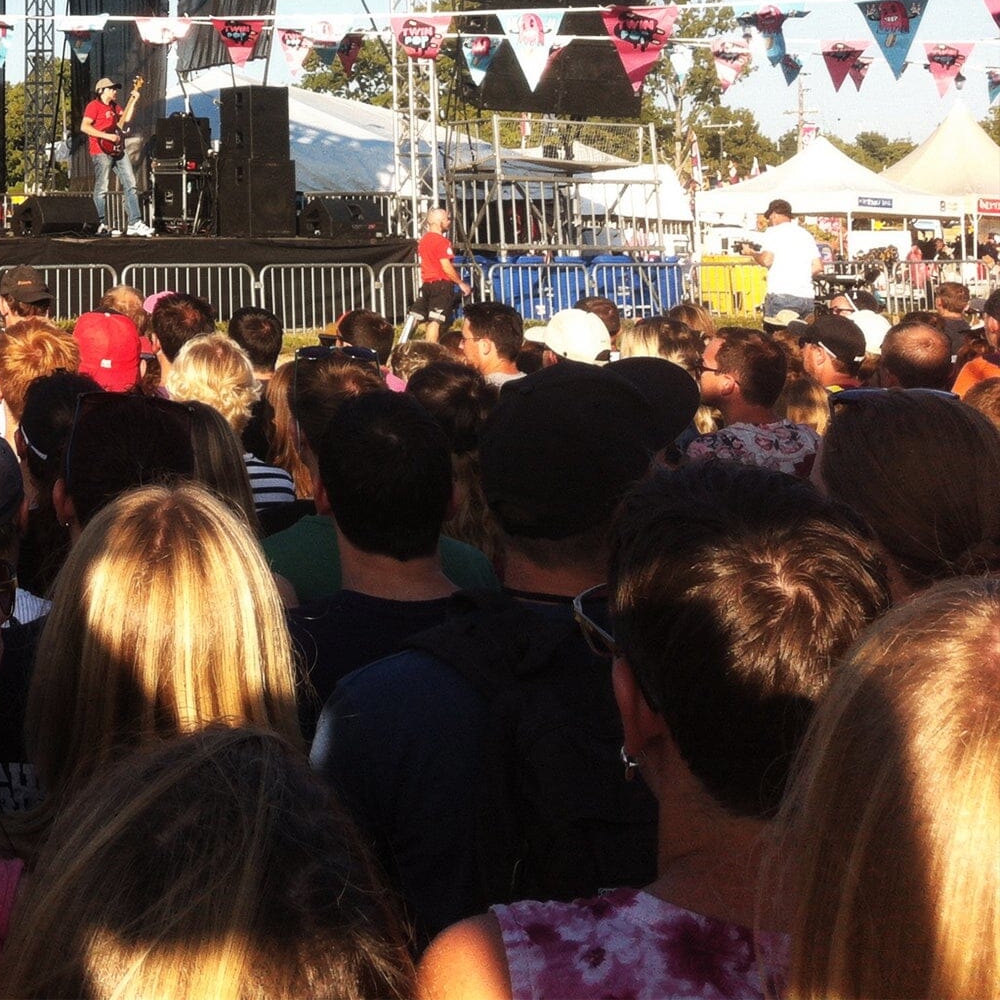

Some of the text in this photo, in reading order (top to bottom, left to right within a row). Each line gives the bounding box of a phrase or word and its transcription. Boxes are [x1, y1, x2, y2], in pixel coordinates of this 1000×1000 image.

[224, 25, 250, 33] TWIN
[402, 26, 433, 37] TWIN
[226, 31, 247, 42] POP
[404, 35, 430, 49] POP
